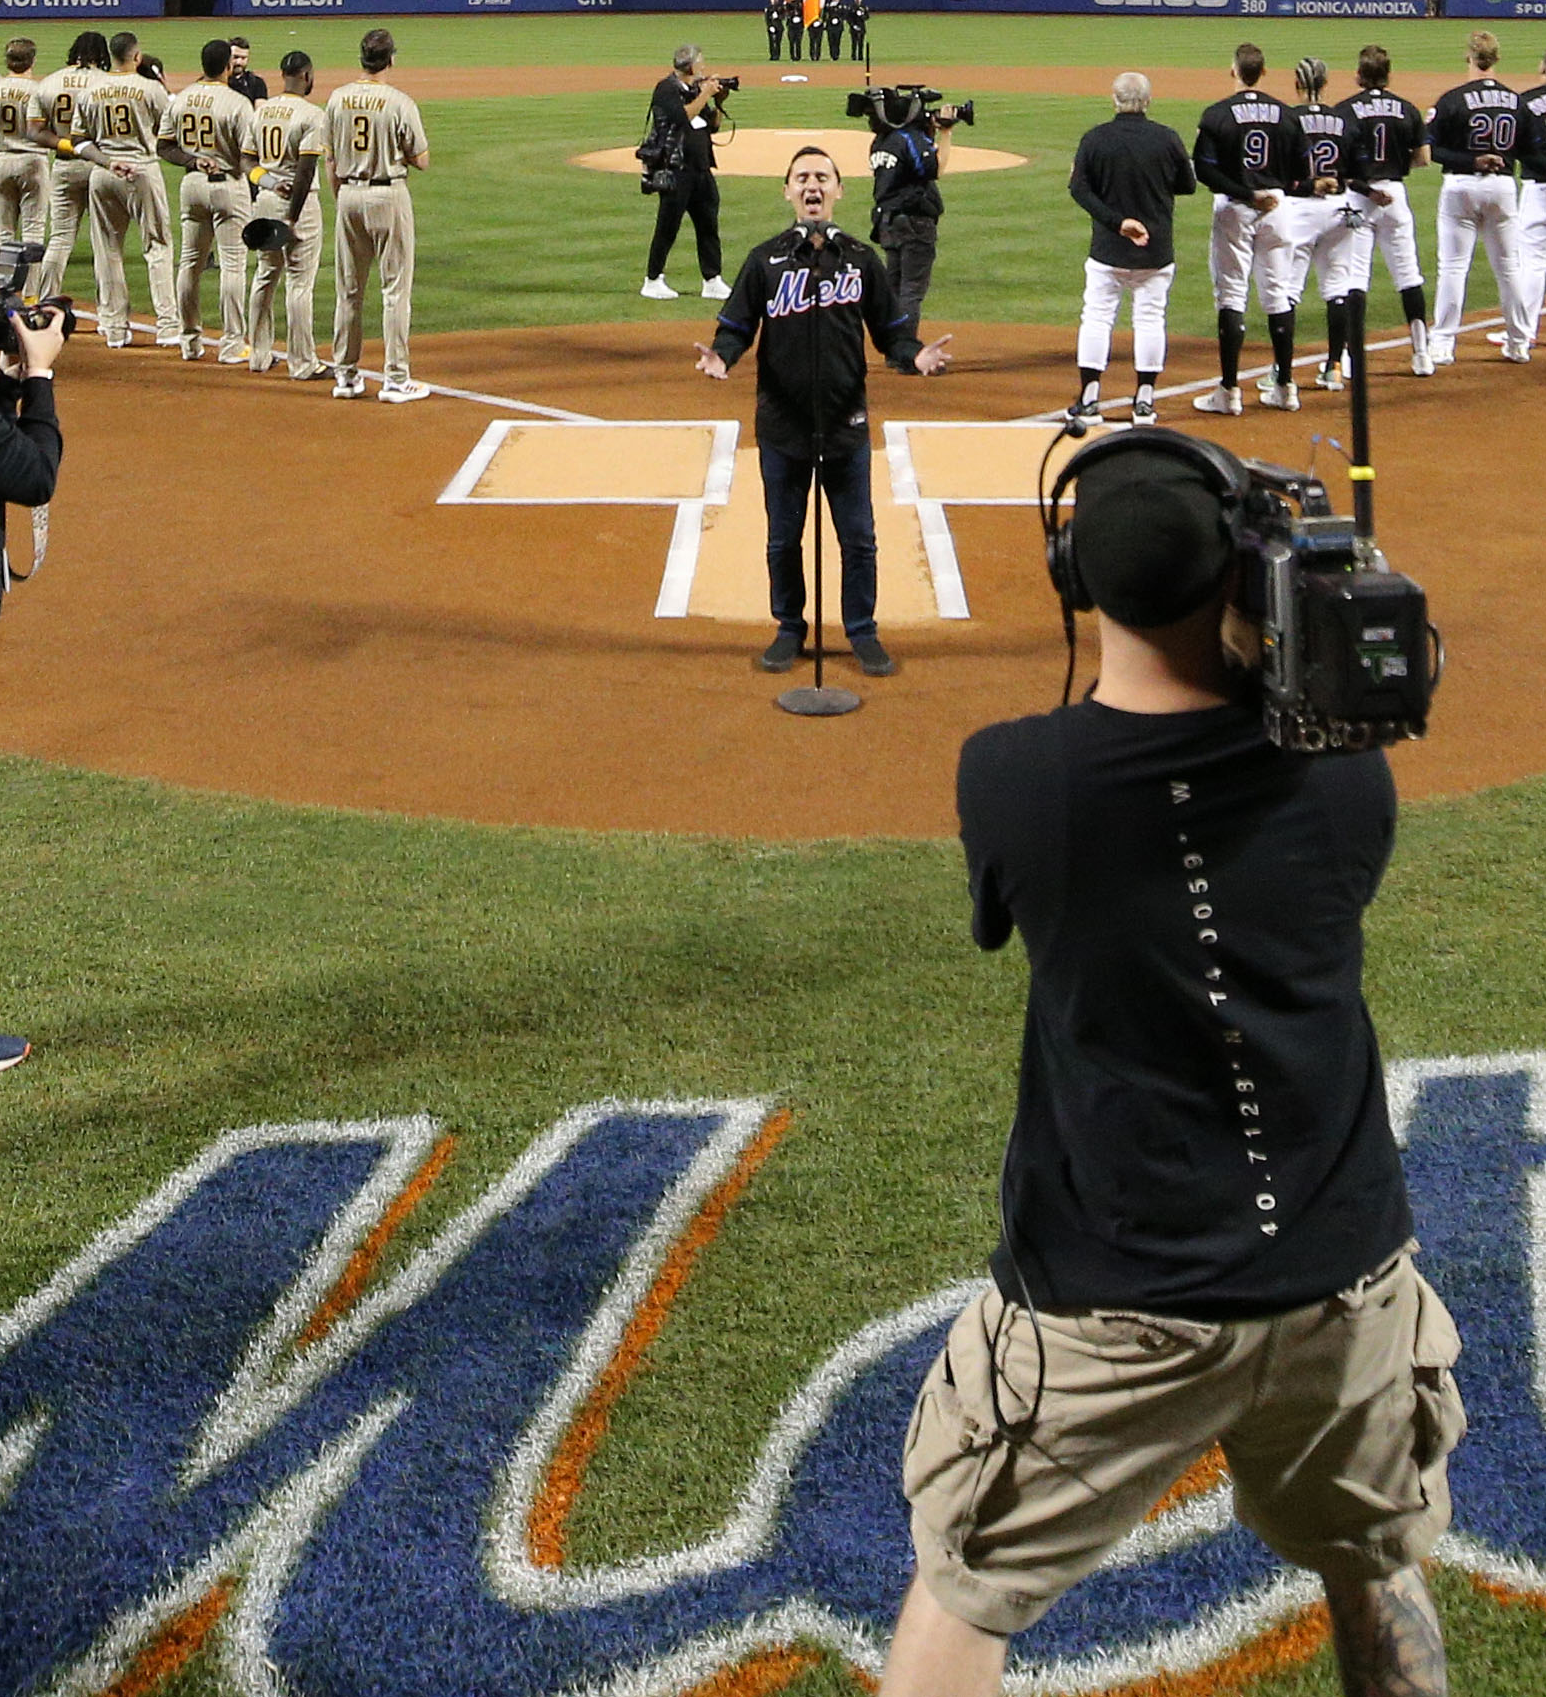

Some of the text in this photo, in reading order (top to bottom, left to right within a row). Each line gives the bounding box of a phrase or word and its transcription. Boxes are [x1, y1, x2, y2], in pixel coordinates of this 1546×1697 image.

[1240, 0, 1267, 13] 380
[1296, 1, 1417, 14] KONICA MINOLTA
[91, 85, 144, 102] MACHADO
[186, 93, 214, 109] SOTO
[342, 95, 386, 112] MELVIN
[1, 105, 17, 133] 9
[104, 104, 132, 136] 13
[182, 113, 215, 149] 22
[353, 115, 370, 152] 3
[1468, 113, 1517, 151] 20
[261, 124, 282, 160] 10
[1243, 129, 1270, 170] 9
[1373, 122, 1386, 162] 1
[767, 263, 863, 319] Mets
[1169, 780, 1192, 804] W
